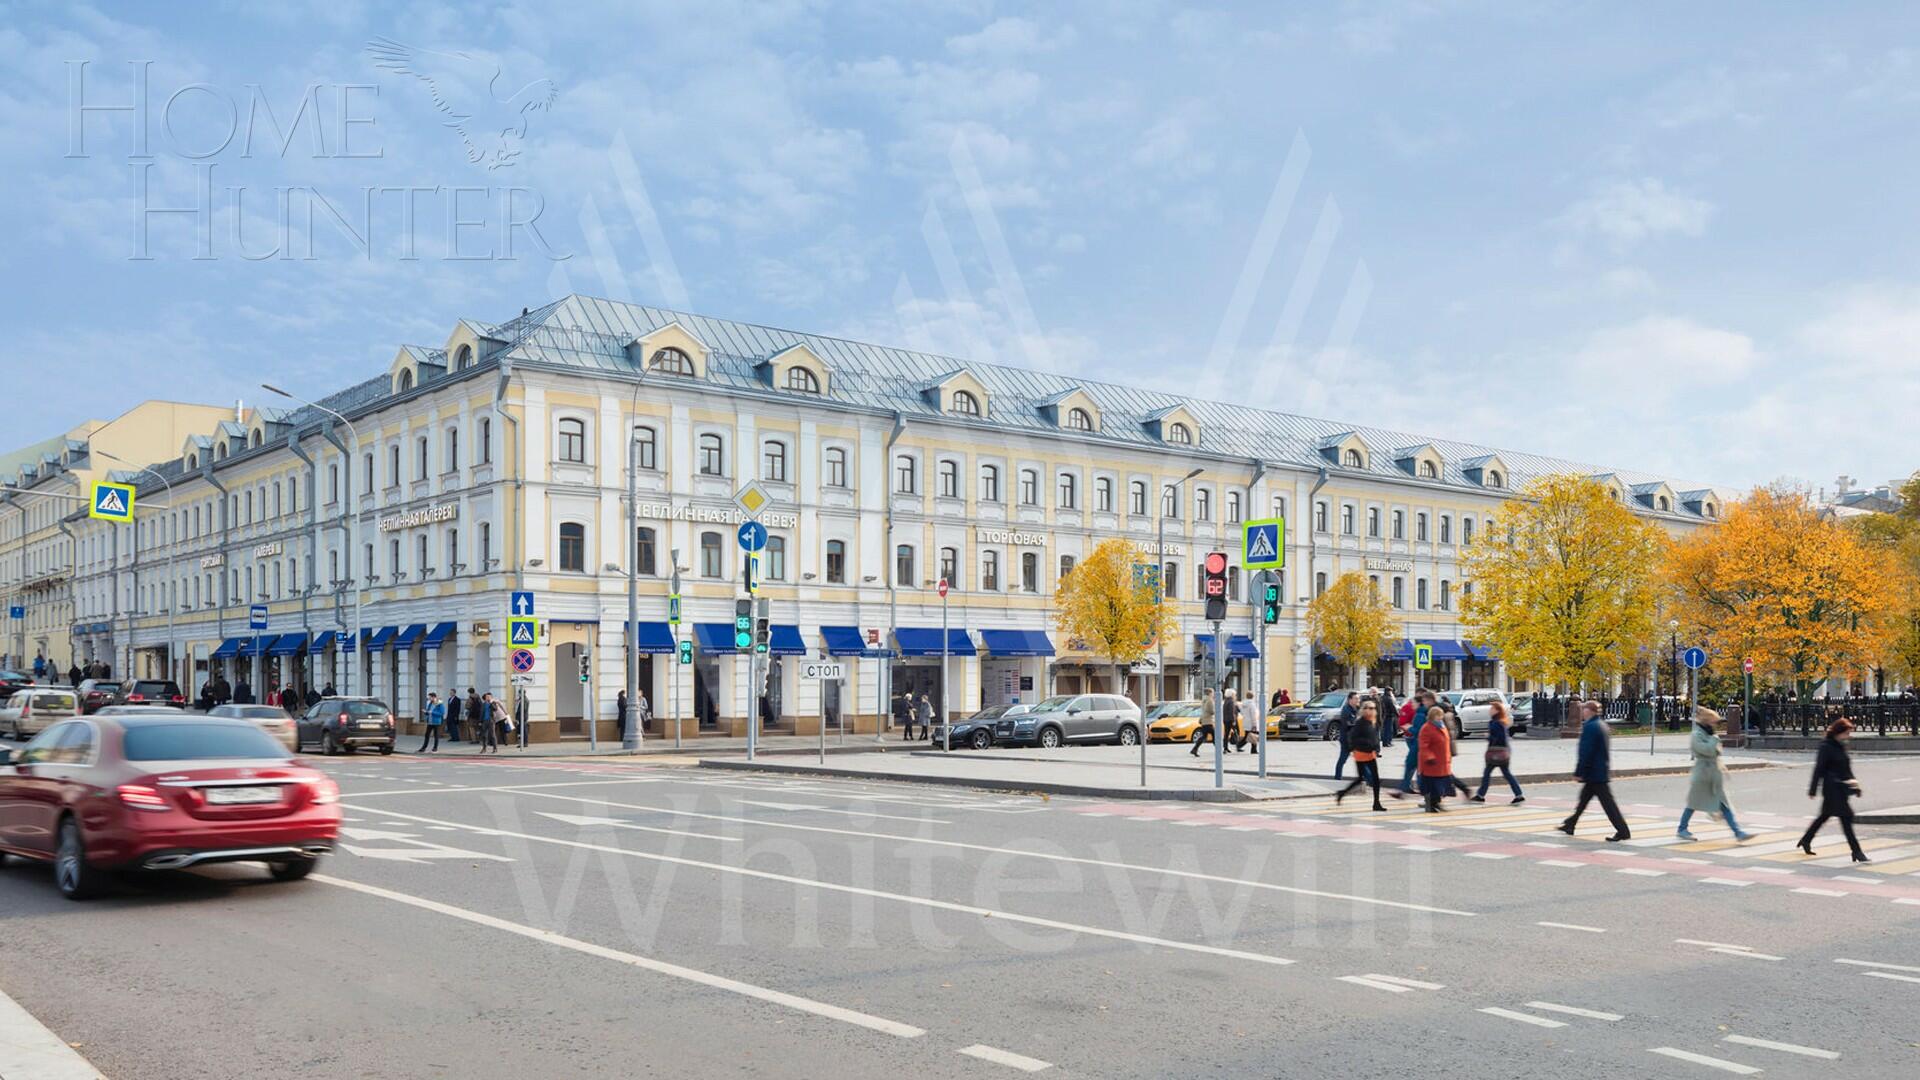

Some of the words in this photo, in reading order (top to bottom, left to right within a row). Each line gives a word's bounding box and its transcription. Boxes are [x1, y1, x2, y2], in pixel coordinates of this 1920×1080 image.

[378, 511, 419, 533] НЕГЛИННАЯ
[420, 504, 452, 525] ГАЛЕРЕЯ
[734, 511, 797, 528] ГАЕРЕЯ
[984, 531, 1046, 546] ТОРГОВАЯ
[1207, 579, 1224, 595] 62
[737, 617, 750, 629] 66
[807, 664, 840, 678] СТОП
